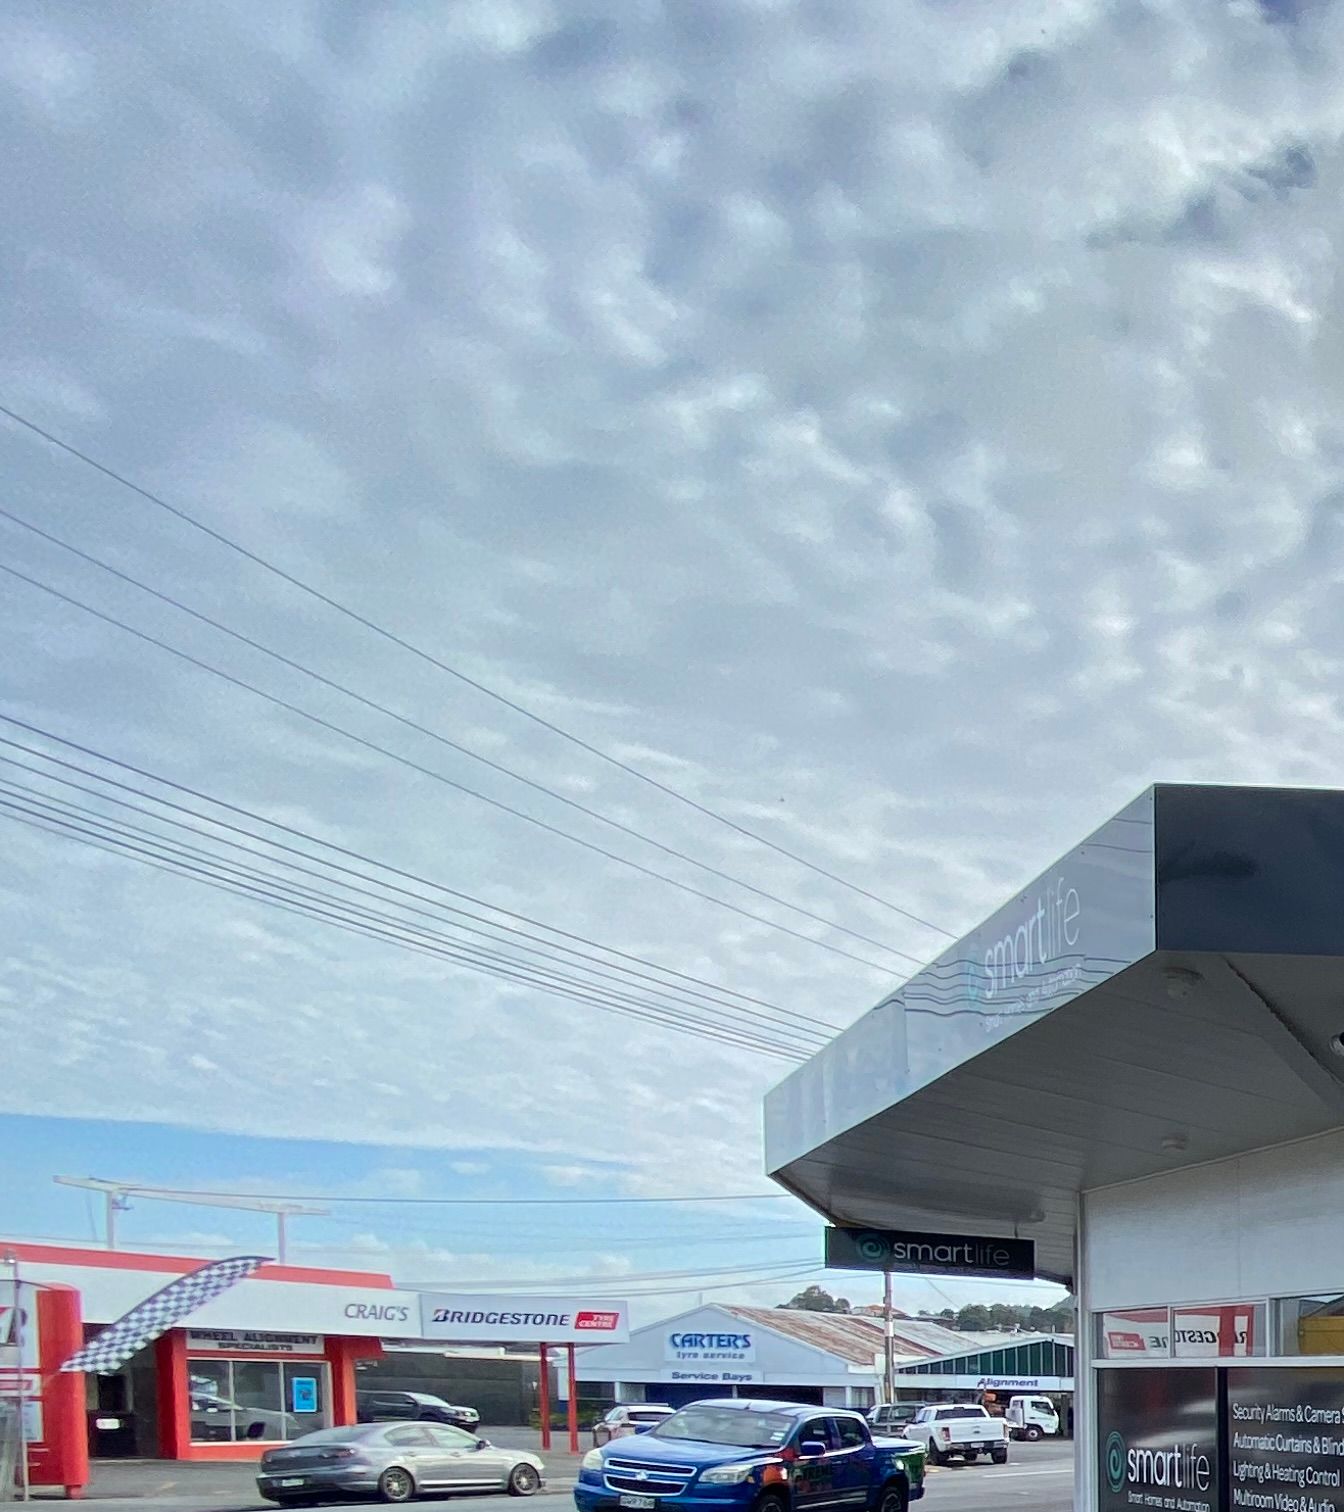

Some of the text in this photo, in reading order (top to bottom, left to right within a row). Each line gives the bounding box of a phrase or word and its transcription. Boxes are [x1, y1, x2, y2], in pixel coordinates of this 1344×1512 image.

[893, 1242, 1010, 1266] smartlife
[345, 1303, 409, 1322] CRAIG'S
[432, 1308, 570, 1327] BRIDGESTONE
[671, 1333, 752, 1350] CARTER'S
[672, 1372, 752, 1382] Service Bays
[977, 1378, 1039, 1388] Alignment
[1232, 1402, 1266, 1424] Security
[1266, 1403, 1295, 1422] Alarms
[1295, 1405, 1304, 1422] &
[1304, 1405, 1341, 1424] Camera
[1233, 1432, 1275, 1450] Automatic
[1276, 1433, 1312, 1454] Curtains
[1313, 1436, 1321, 1454] &
[1127, 1443, 1210, 1491] smartlife
[1232, 1461, 1340, 1488] Lighting & Heating Control
[1233, 1488, 1274, 1509] Multiroom
[1274, 1493, 1299, 1512] Video
